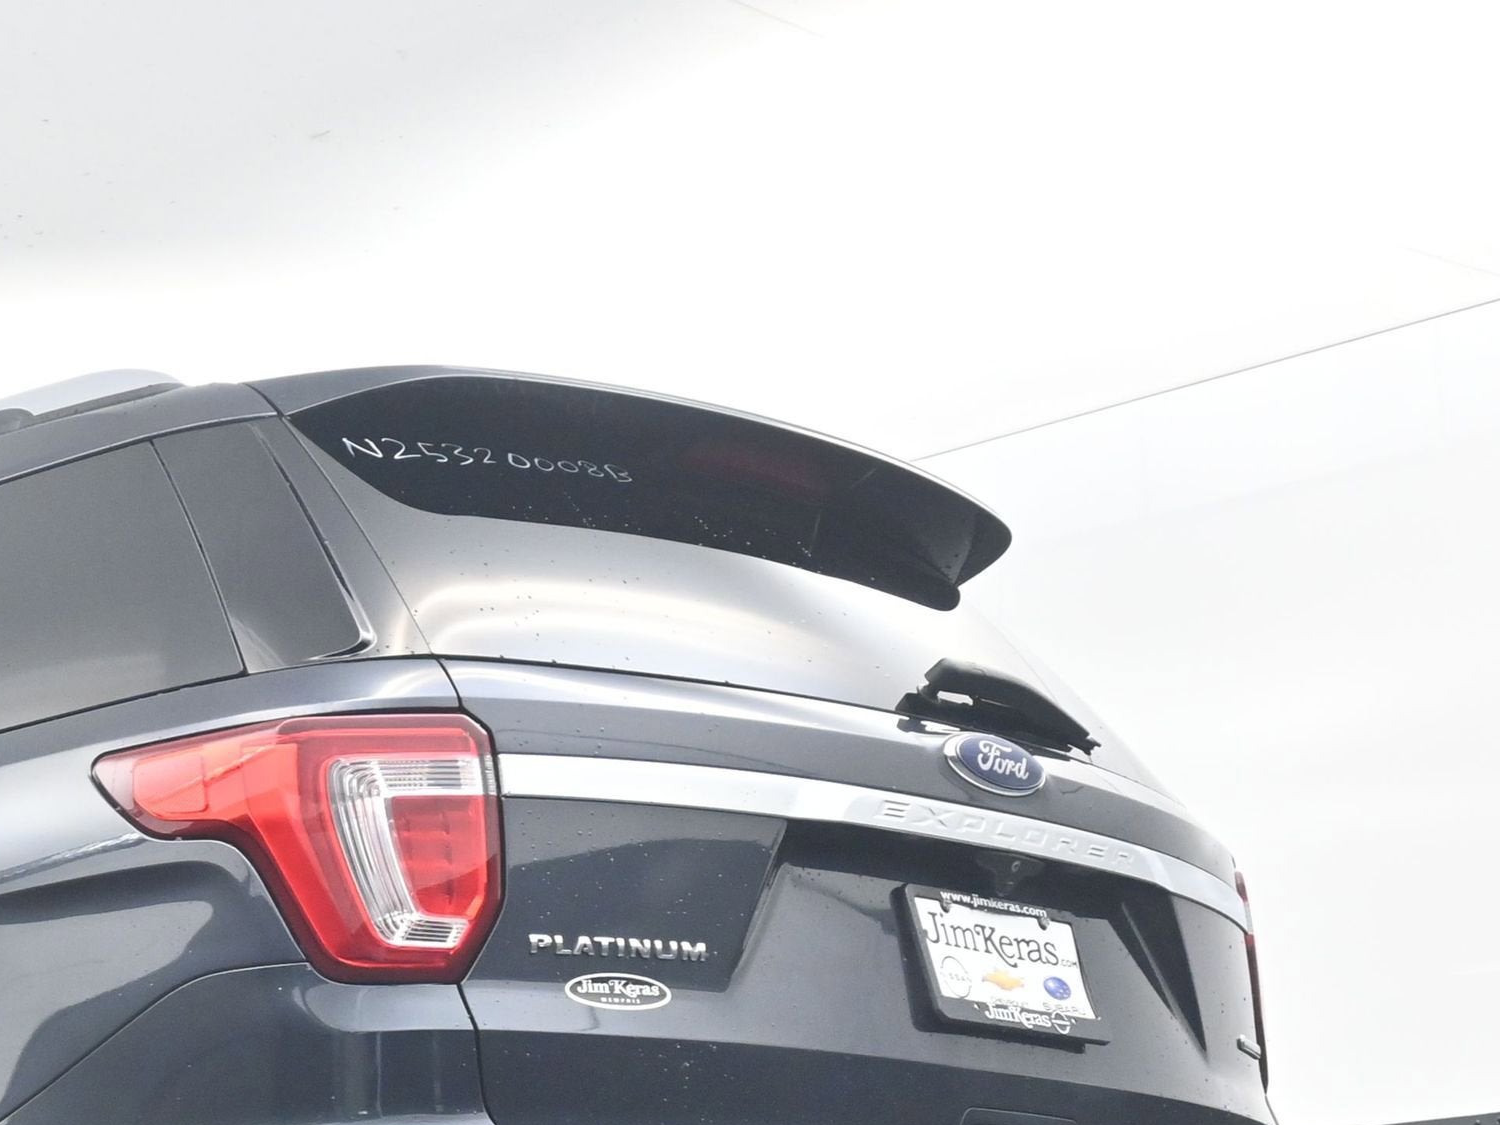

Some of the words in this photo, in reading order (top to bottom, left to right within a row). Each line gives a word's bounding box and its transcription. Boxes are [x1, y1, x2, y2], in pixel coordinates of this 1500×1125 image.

[978, 740, 1030, 781] Ford
[873, 799, 1135, 868] EXPLORER
[940, 890, 1048, 917] www.jimkeras.com
[528, 933, 708, 962] PLATINUM
